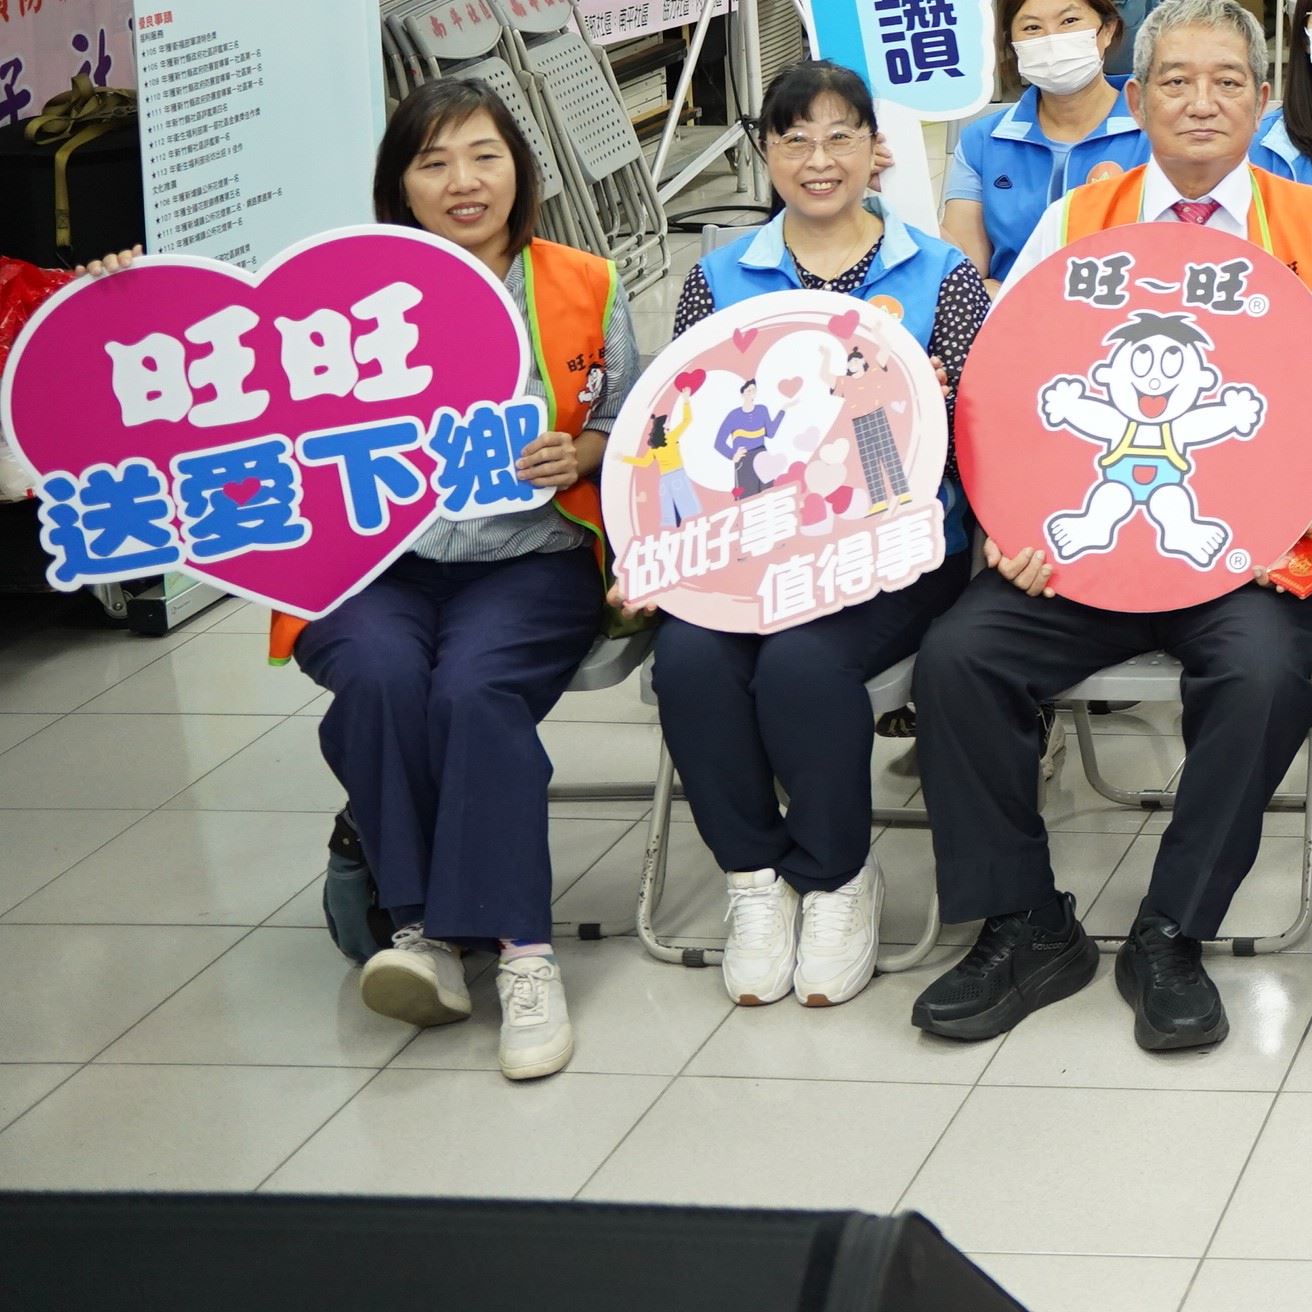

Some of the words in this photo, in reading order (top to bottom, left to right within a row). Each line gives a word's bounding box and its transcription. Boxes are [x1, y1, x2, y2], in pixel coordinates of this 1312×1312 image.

[104, 281, 434, 427] 旺旺
[48, 402, 541, 583] 送愛下鄉
[621, 486, 800, 600] 做好事
[757, 509, 937, 625] 值得事
